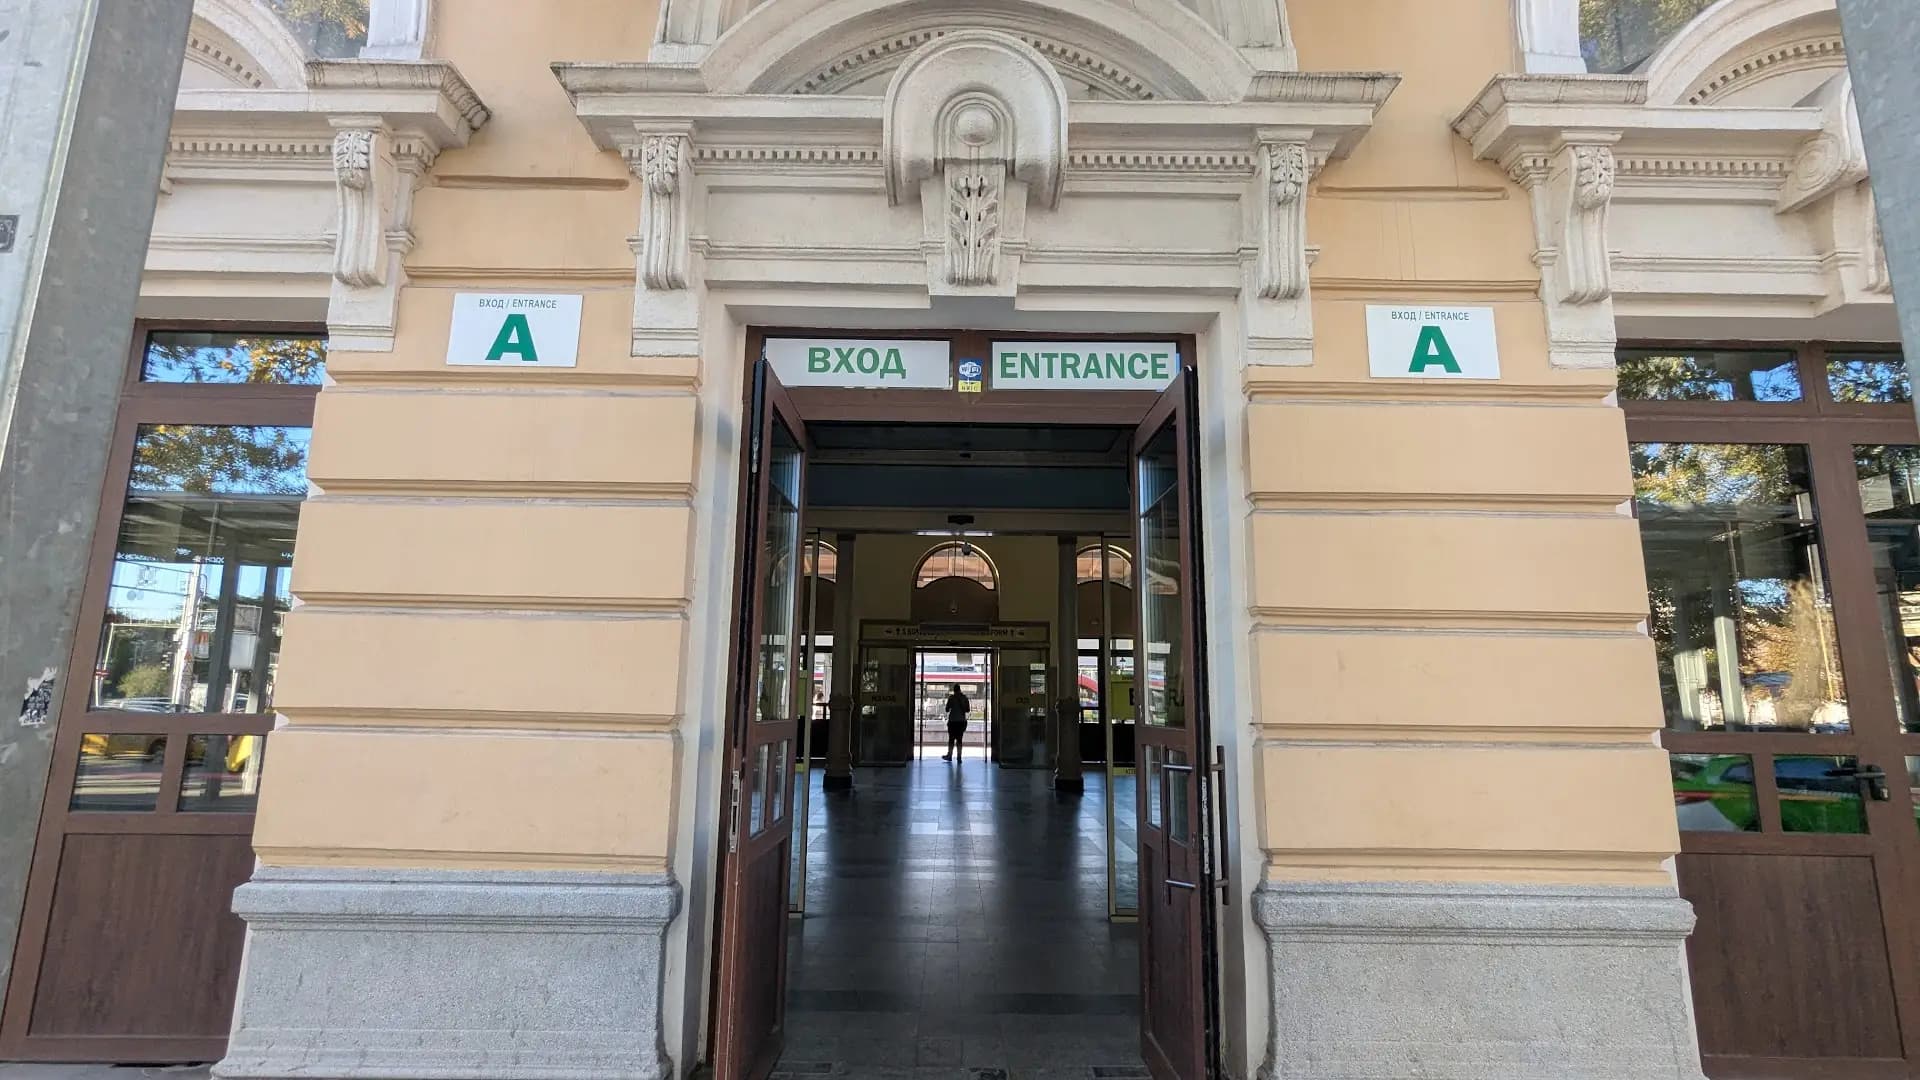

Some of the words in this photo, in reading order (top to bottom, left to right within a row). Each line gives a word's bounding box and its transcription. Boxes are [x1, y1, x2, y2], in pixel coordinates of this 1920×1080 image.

[479, 299, 504, 310] ВХОД
[512, 299, 557, 309] ENTRANCE
[1391, 311, 1417, 322] ВХОД
[1424, 311, 1470, 321] ENTRANCE
[485, 313, 538, 361] A
[1408, 325, 1462, 373] A
[807, 346, 907, 379] ВХОД
[1000, 352, 1170, 380] ENTRANCE
